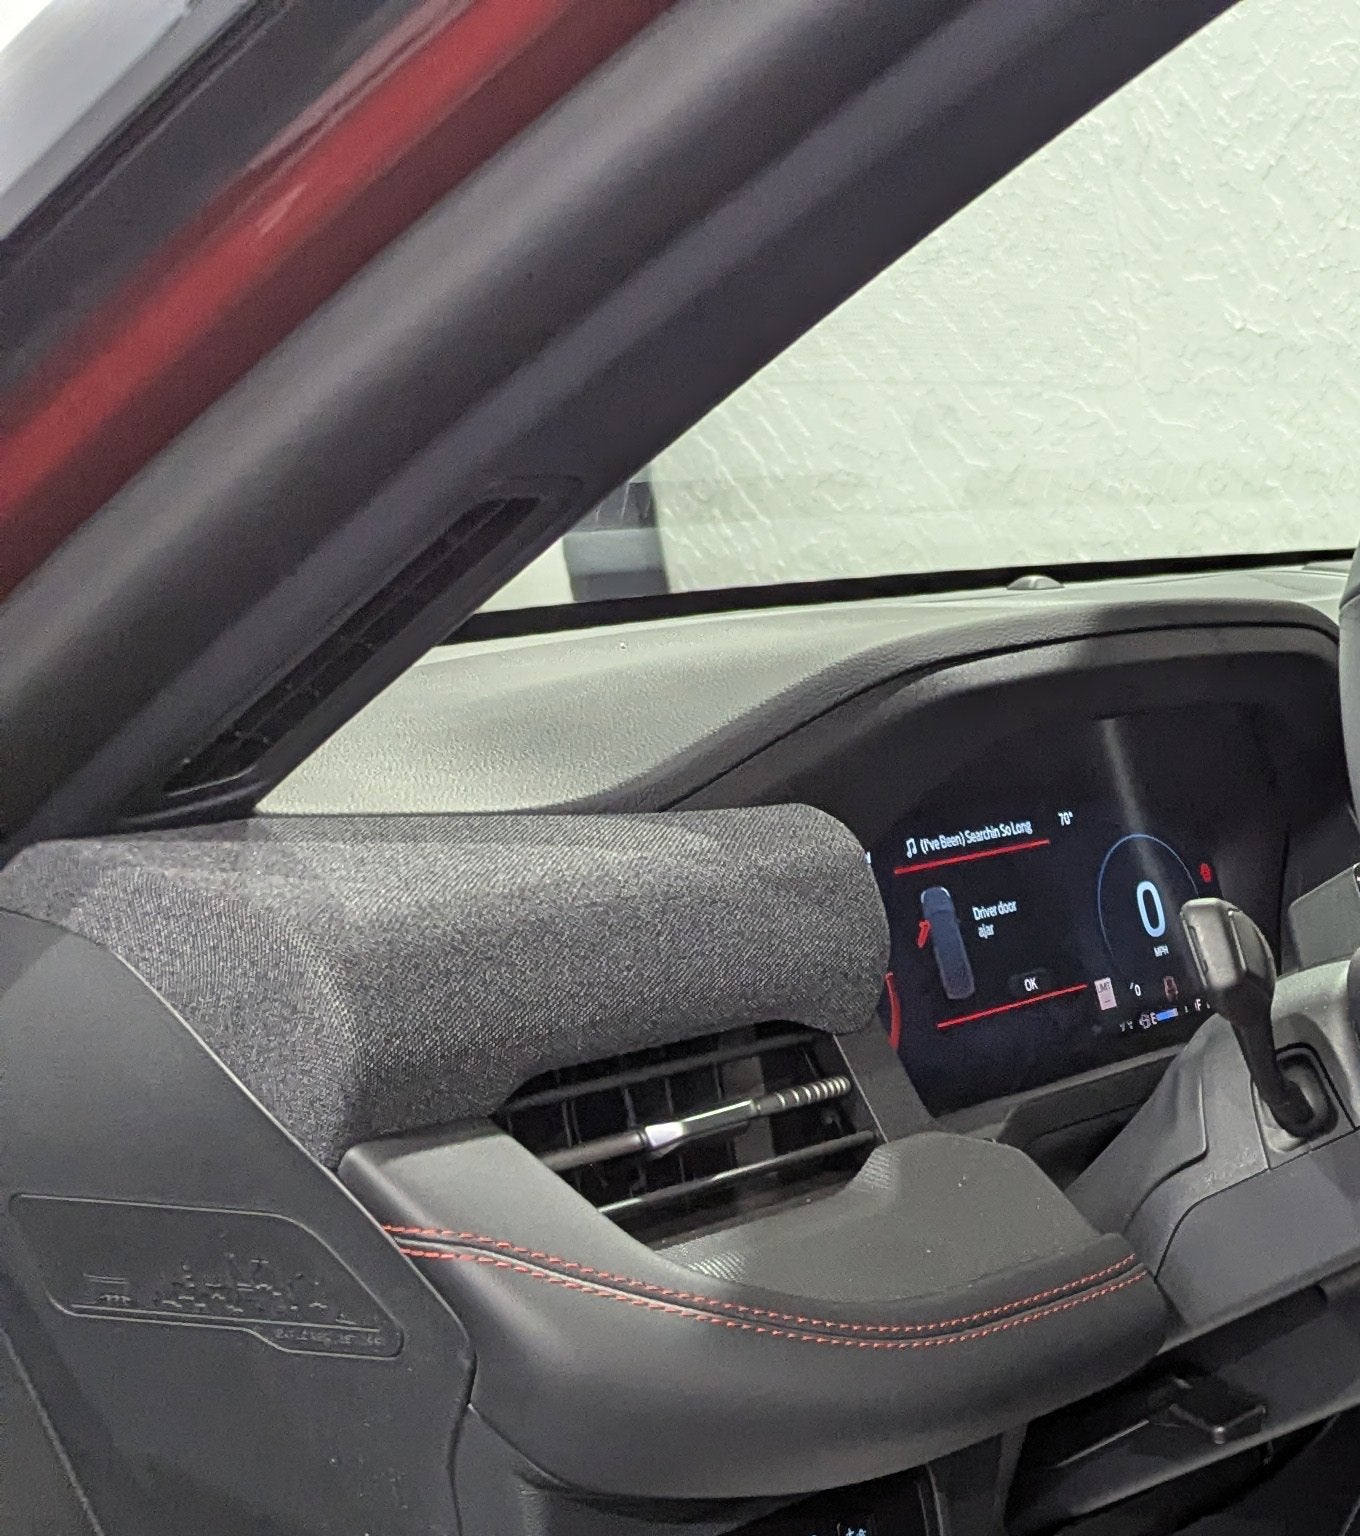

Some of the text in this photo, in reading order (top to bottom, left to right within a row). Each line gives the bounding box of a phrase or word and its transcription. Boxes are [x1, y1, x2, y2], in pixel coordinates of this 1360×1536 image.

[939, 831, 967, 848] Been)
[1010, 820, 1034, 836] Long
[972, 900, 1018, 921] Driver door
[1136, 880, 1167, 938] 0
[978, 923, 995, 940] ajar
[1023, 977, 1040, 992] OK
